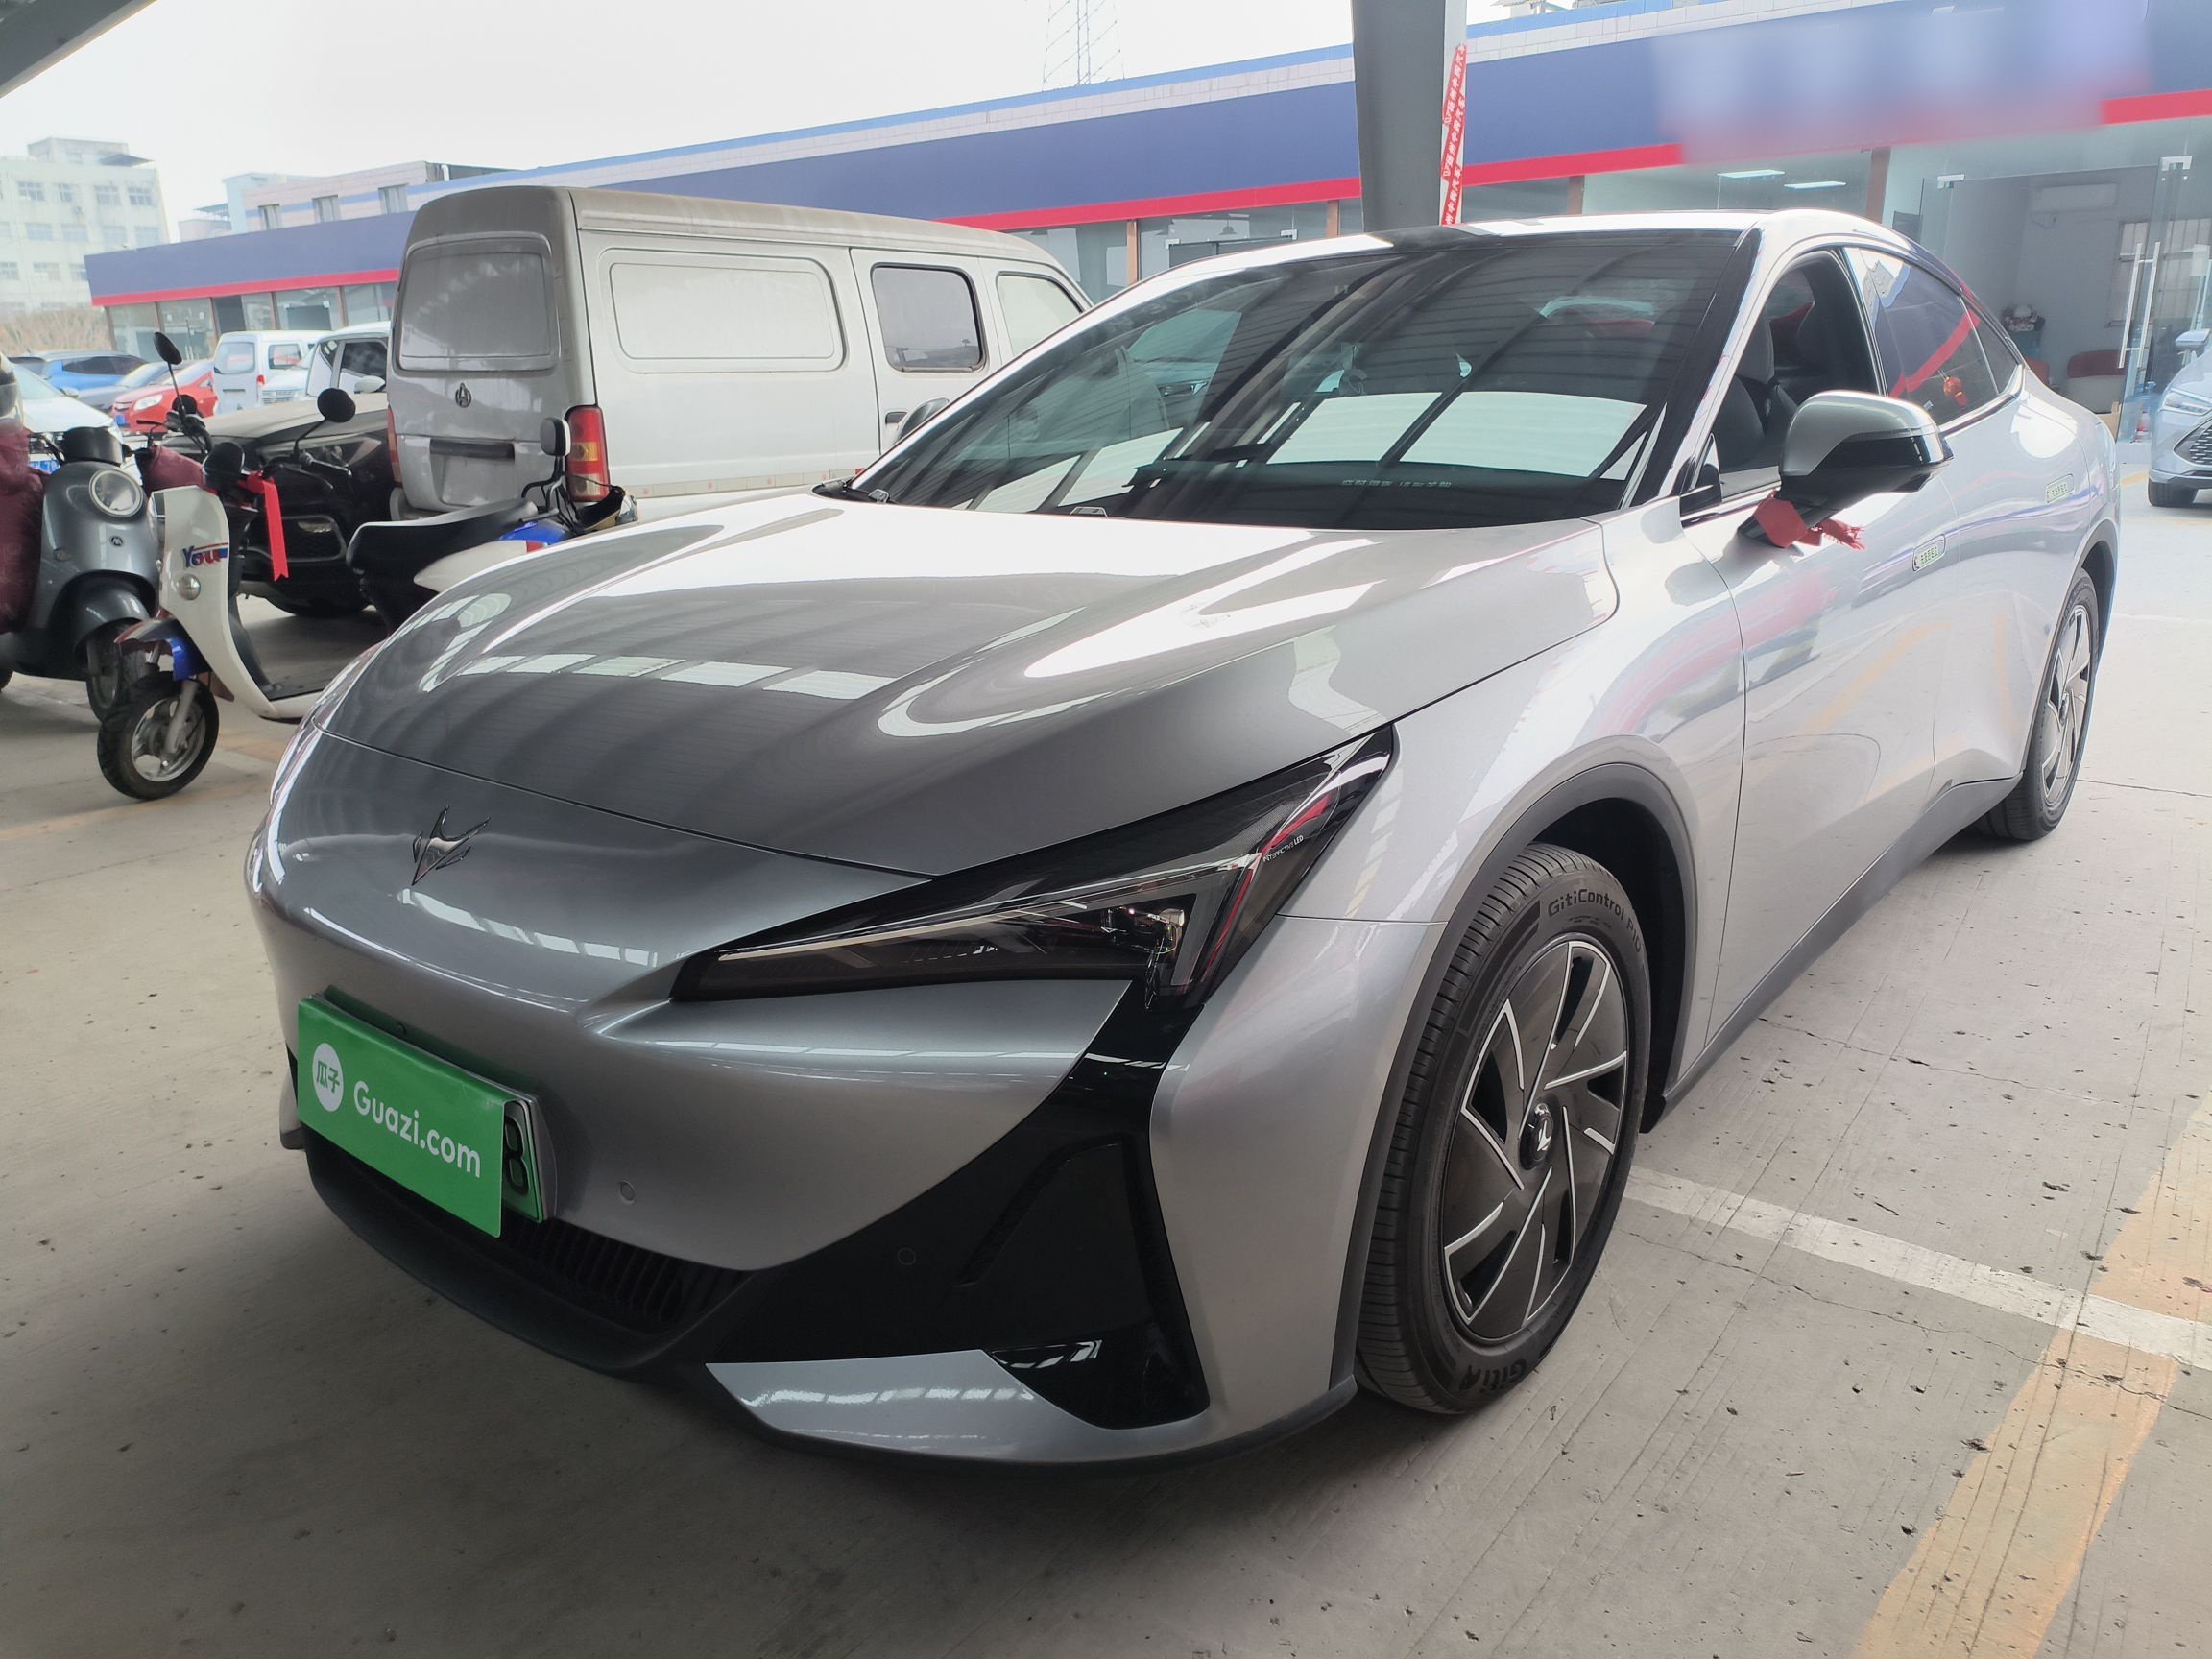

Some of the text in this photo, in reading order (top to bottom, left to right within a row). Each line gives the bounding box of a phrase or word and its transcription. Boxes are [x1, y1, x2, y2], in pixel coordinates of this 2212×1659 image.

[1293, 834, 1304, 846] LED
[1547, 888, 1625, 921] GitiControl
[315, 1059, 340, 1094] 瓜子
[352, 1080, 481, 1179] Guazi.com
